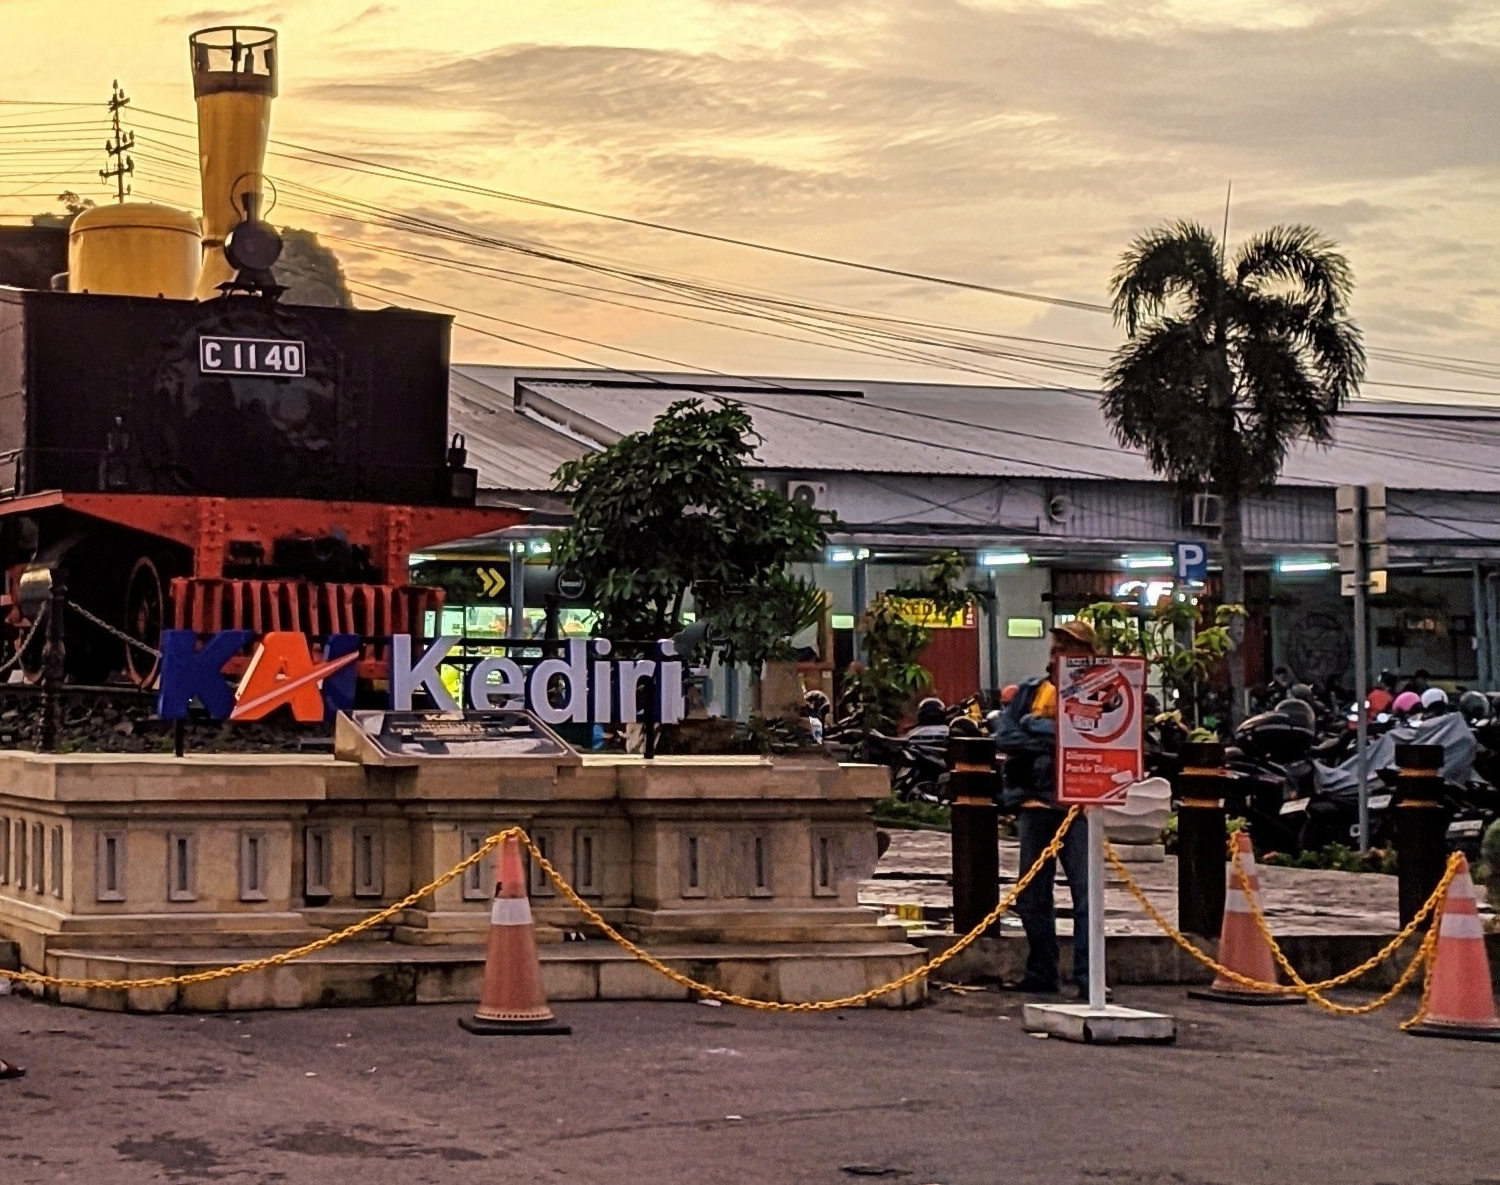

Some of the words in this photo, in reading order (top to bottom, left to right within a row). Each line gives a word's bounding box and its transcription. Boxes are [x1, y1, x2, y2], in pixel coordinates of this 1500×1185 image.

[205, 342, 221, 368] C
[1178, 543, 1204, 578] P
[160, 629, 360, 722] KAI
[389, 633, 686, 724] Kediri
